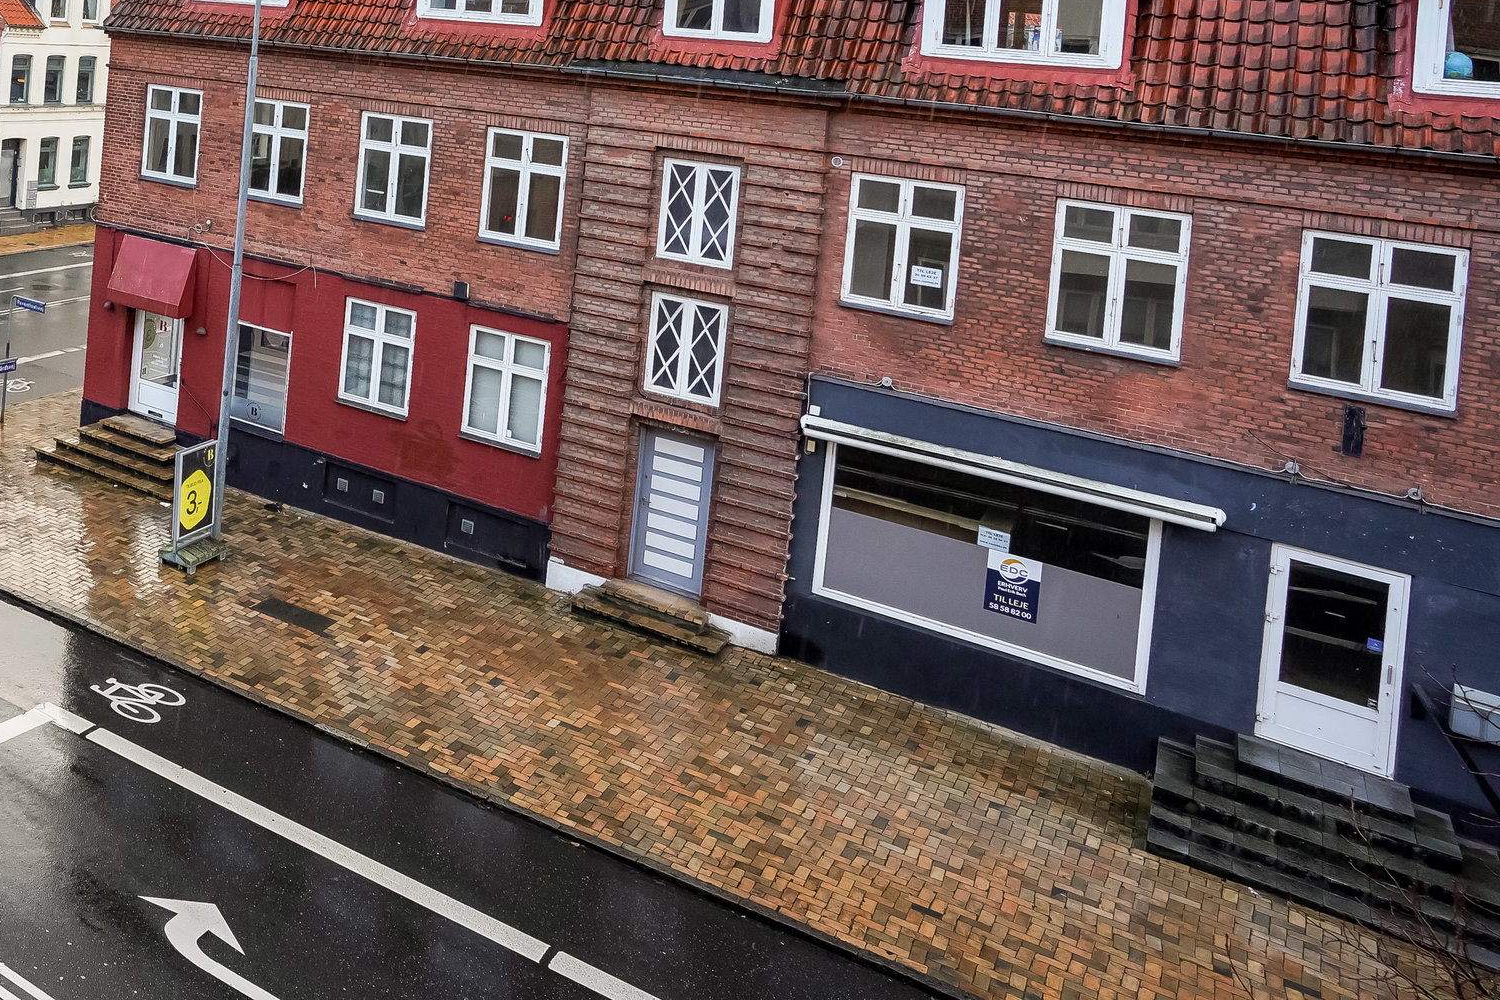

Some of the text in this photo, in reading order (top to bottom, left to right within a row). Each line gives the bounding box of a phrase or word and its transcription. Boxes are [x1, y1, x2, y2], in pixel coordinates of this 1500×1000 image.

[160, 320, 167, 332] B
[251, 406, 258, 416] B
[208, 449, 214, 461] B
[1000, 565, 1028, 577] EDC
[997, 580, 1028, 593] ERHVERV
[989, 602, 999, 610] 58
[1000, 605, 1010, 613] 58
[994, 594, 1029, 610] TIL LEJE
